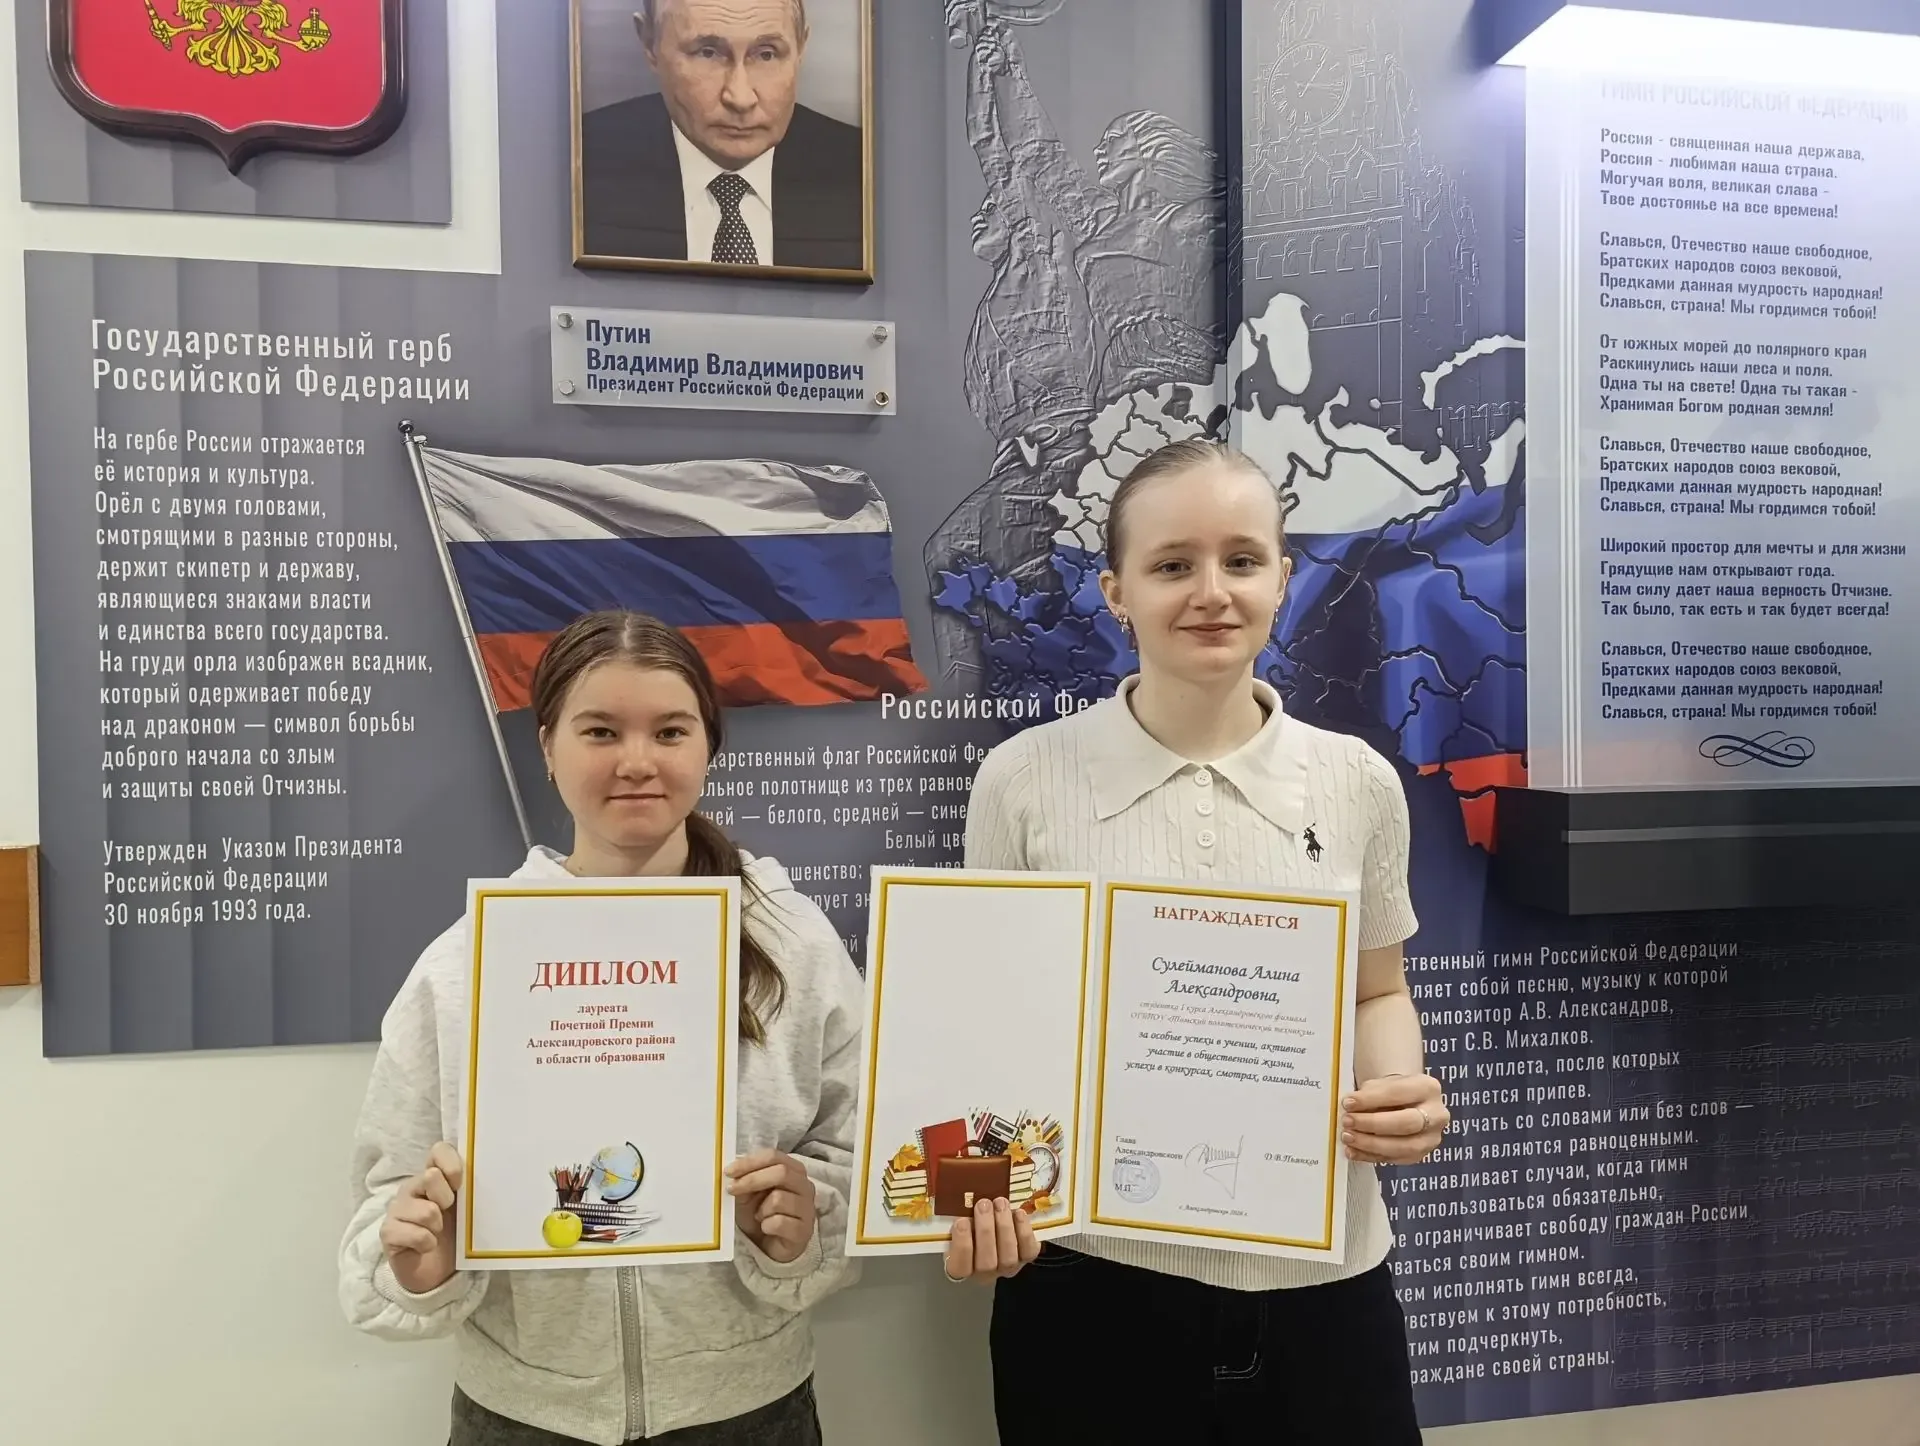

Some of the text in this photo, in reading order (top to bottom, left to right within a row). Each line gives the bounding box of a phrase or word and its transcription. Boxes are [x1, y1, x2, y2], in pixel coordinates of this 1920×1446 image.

[1600, 190, 1838, 218] Твое достоянье на все времена!
[1600, 231, 1872, 261] Славься, Отечество наше свободное,
[92, 319, 452, 368] Государственный герб
[586, 319, 650, 346] Путин
[1600, 334, 1866, 360] От южных морей до полярного края
[587, 348, 864, 384] Владимир Владимирович
[93, 358, 469, 404] Российской Федерации
[587, 373, 864, 402] Президент Российской Федерации
[1600, 395, 1833, 416] Хранимая Богом родная земля!
[94, 427, 364, 458] На гербе России отражается
[94, 462, 314, 490] её история и культура.
[96, 490, 326, 519] Орёл с двумя головами,
[96, 528, 398, 552] смотрящими в разные стороны,
[1600, 537, 1906, 556] Широкий простор для мечты и для жизни
[97, 560, 360, 583] держит скипетр и державу,
[98, 592, 370, 612] являющиеся знаками власти
[882, 692, 1040, 720] Российской
[708, 746, 815, 772] дарственный
[822, 746, 860, 770] флаг
[867, 744, 957, 764] Российской
[761, 779, 849, 797] полотнище
[856, 778, 872, 793] из
[879, 778, 912, 797] трех
[920, 776, 972, 796] равнов
[103, 835, 402, 866] Утвержден Указом Президента
[886, 829, 935, 849] Белый
[104, 867, 327, 894] Российской Федерации
[104, 898, 311, 927] 30 ноября 1993 года.
[1154, 906, 1298, 930] НАГРАЖДАЕТСЯ
[1494, 952, 1532, 968] гимн
[1540, 944, 1637, 966] Российской
[1645, 940, 1737, 962] Федерации
[530, 960, 678, 992] ДИПЛОМ
[1152, 956, 1300, 982] Сулейманова Алина
[1164, 979, 1280, 1004] Александровна,
[577, 1005, 628, 1016] лауреата
[1421, 999, 1673, 1026] омпозитор А.В. Александров,
[550, 1019, 606, 1031] Почетной
[526, 1034, 675, 1050] Александровского района
[1150, 1031, 1182, 1041] особые
[1182, 1035, 1214, 1046] успехи
[1222, 1040, 1258, 1050] учении,
[1260, 1043, 1306, 1054] активное
[1465, 1030, 1593, 1051] С.В. Михалков.
[546, 1053, 591, 1064] области
[594, 1052, 665, 1066] образования
[1146, 1048, 1185, 1058] участие
[1194, 1049, 1260, 1065] общественной
[1260, 1059, 1294, 1070] жизни,
[1439, 1052, 1680, 1084] три куплета, после которых
[1124, 1062, 1156, 1072] успехи
[1164, 1065, 1213, 1078] конкурсах,
[1216, 1070, 1260, 1083] смотрах,
[1262, 1075, 1321, 1090] олимпиадах
[1390, 1157, 1688, 1196] устанавливает случаи, когда гимн
[1407, 1186, 1662, 1220] использоваться обязательно,
[1415, 1204, 1747, 1249] ограничивает свободу граждан России
[1410, 1350, 1614, 1388] раждане своей страны.
